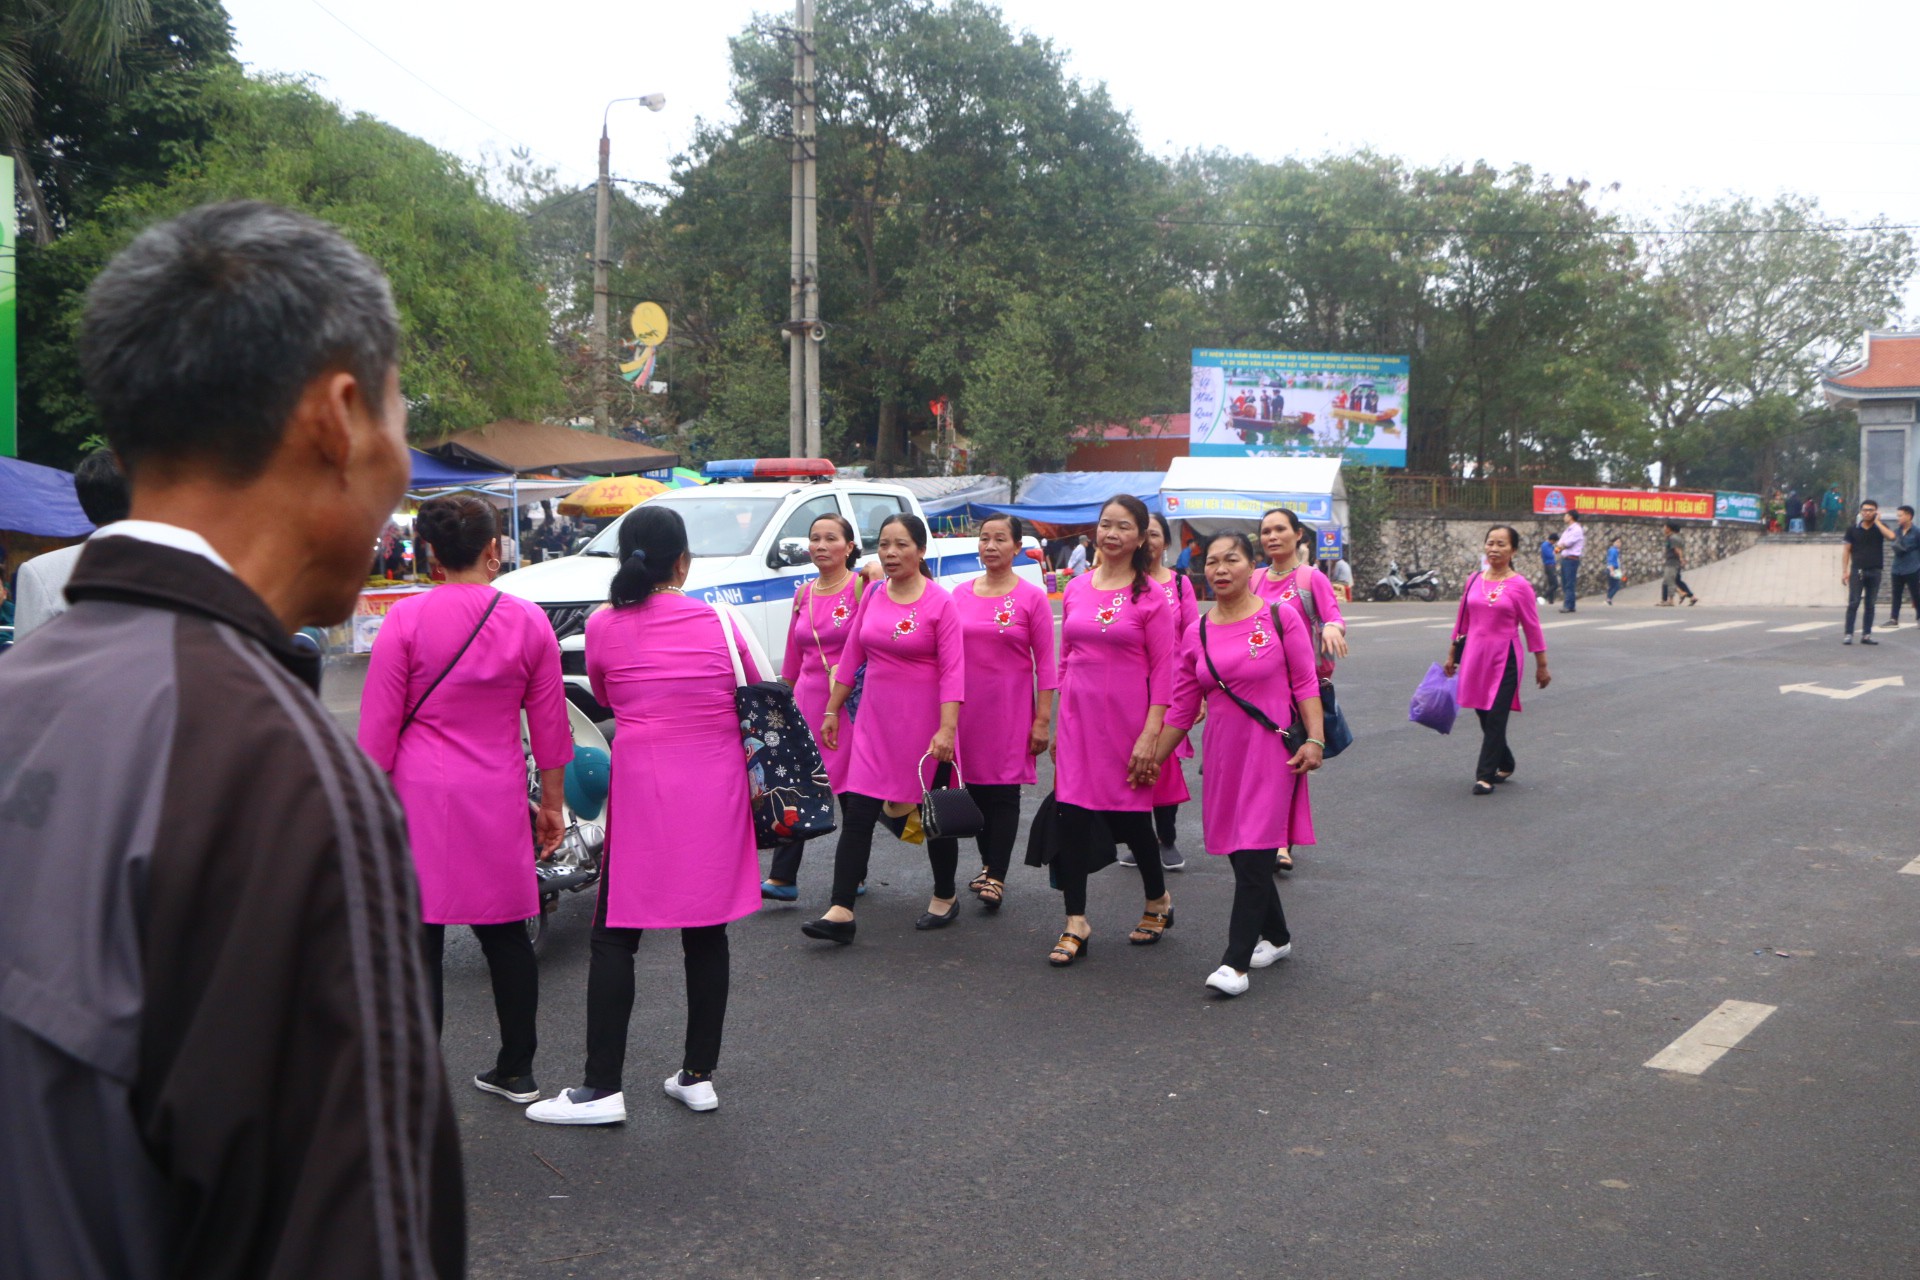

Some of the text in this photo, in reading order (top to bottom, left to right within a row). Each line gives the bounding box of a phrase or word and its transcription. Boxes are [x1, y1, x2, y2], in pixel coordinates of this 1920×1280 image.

[1574, 493, 1708, 515] TÍNH MẠNG CON NGƯỜI LÀ TRÊN HẾT
[703, 586, 743, 604] CẢNH
